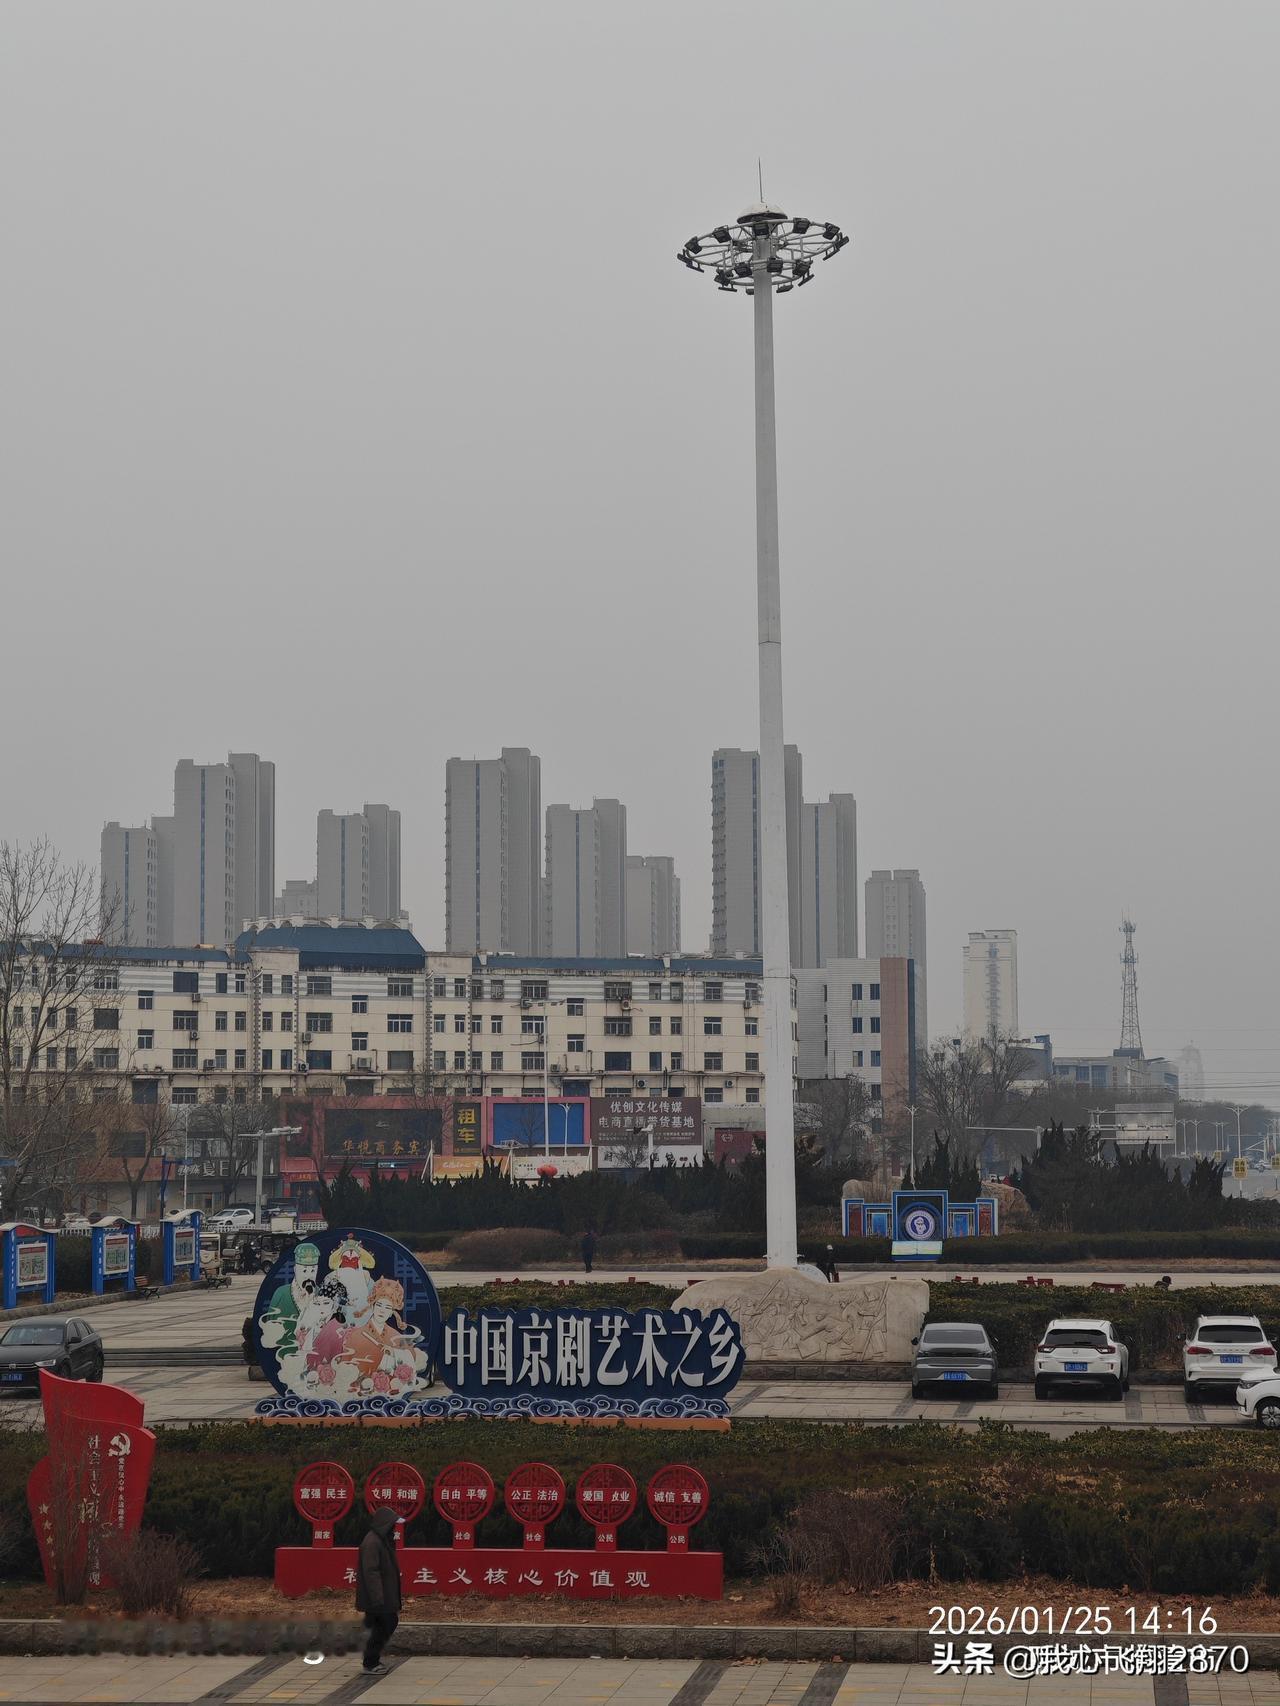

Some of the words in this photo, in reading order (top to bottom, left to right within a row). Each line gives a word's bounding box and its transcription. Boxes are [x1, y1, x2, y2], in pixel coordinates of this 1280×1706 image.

[610, 1100, 682, 1114] 优创文化传媒
[457, 1108, 476, 1143] 租车
[445, 1313, 740, 1387] 中国京剧艺术之乡
[300, 1488, 321, 1499] 富强
[326, 1488, 347, 1499] 民主
[371, 1488, 392, 1499] 文明
[397, 1489, 418, 1500] 和谐
[441, 1489, 461, 1500] 自由
[466, 1489, 487, 1500] 平等
[511, 1490, 532, 1500] 公正
[537, 1490, 558, 1500] 法治
[583, 1490, 604, 1502] 爱国
[654, 1491, 675, 1503] 诚信
[314, 1530, 331, 1540] 国家
[455, 1532, 472, 1541] 社会
[526, 1533, 542, 1542] 社会
[598, 1534, 614, 1543] 公民
[669, 1535, 685, 1544] 公民
[343, 1567, 650, 1588] 社主义核心价值观
